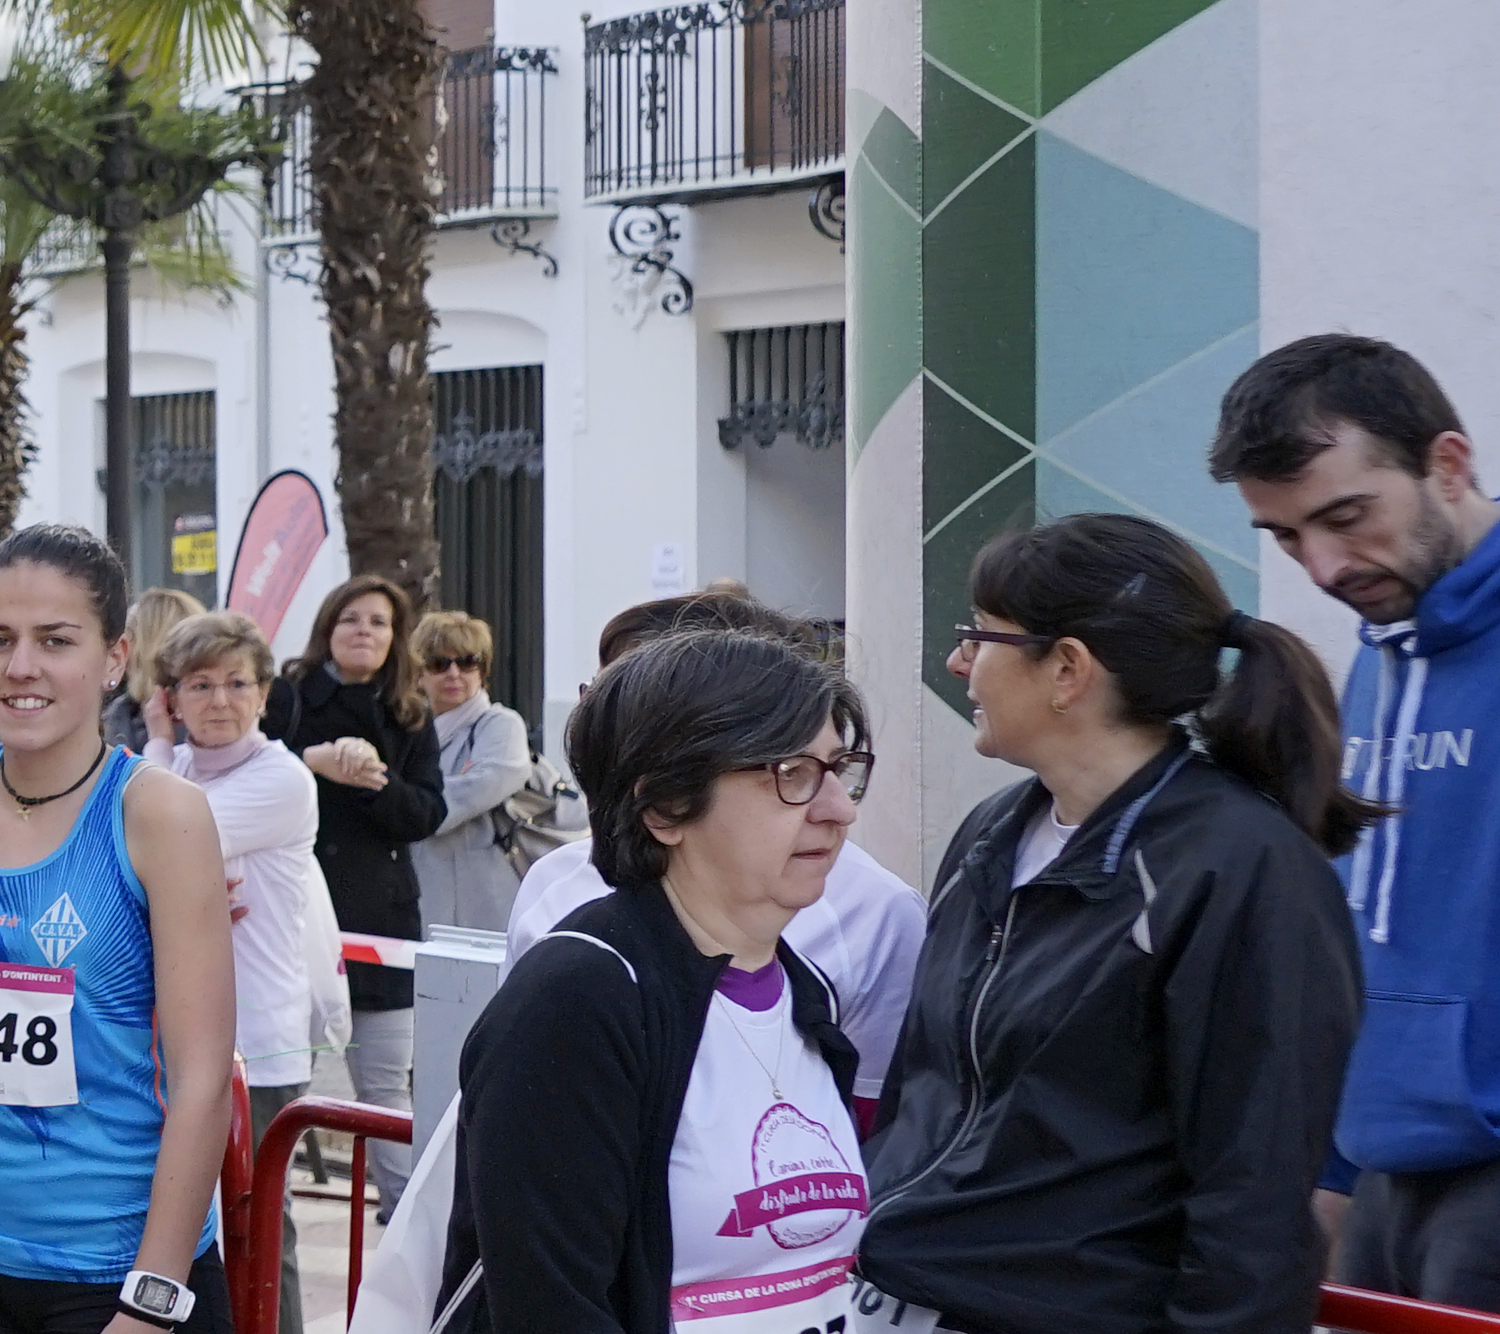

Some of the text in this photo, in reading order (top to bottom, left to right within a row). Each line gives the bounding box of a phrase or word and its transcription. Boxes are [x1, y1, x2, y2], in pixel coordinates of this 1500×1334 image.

[699, 1291, 744, 1306] CURSA
[744, 1286, 763, 1299] DE
[763, 1284, 777, 1296] LA
[777, 1279, 803, 1294] DONA
